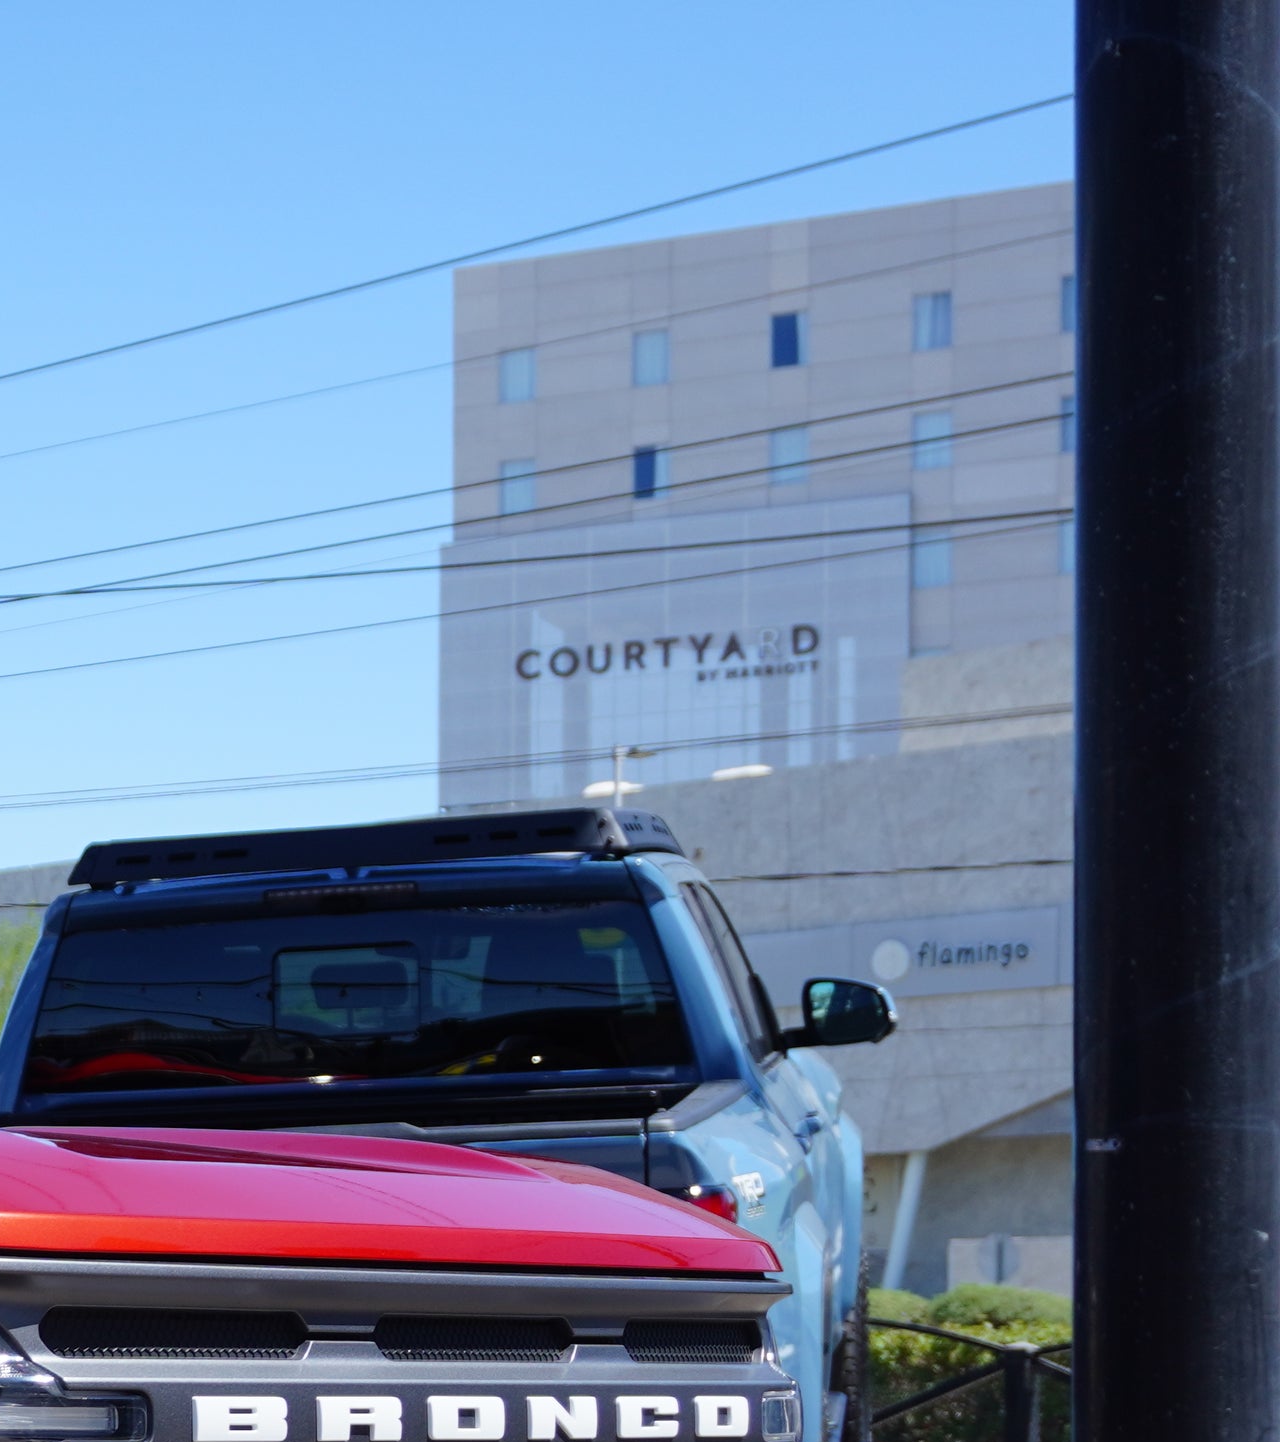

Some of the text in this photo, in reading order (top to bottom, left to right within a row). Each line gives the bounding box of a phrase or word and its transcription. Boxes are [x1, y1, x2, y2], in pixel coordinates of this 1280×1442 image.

[515, 623, 820, 681] COURTYARD
[725, 660, 819, 681] MARRIOTT
[918, 941, 1029, 969] flamingo
